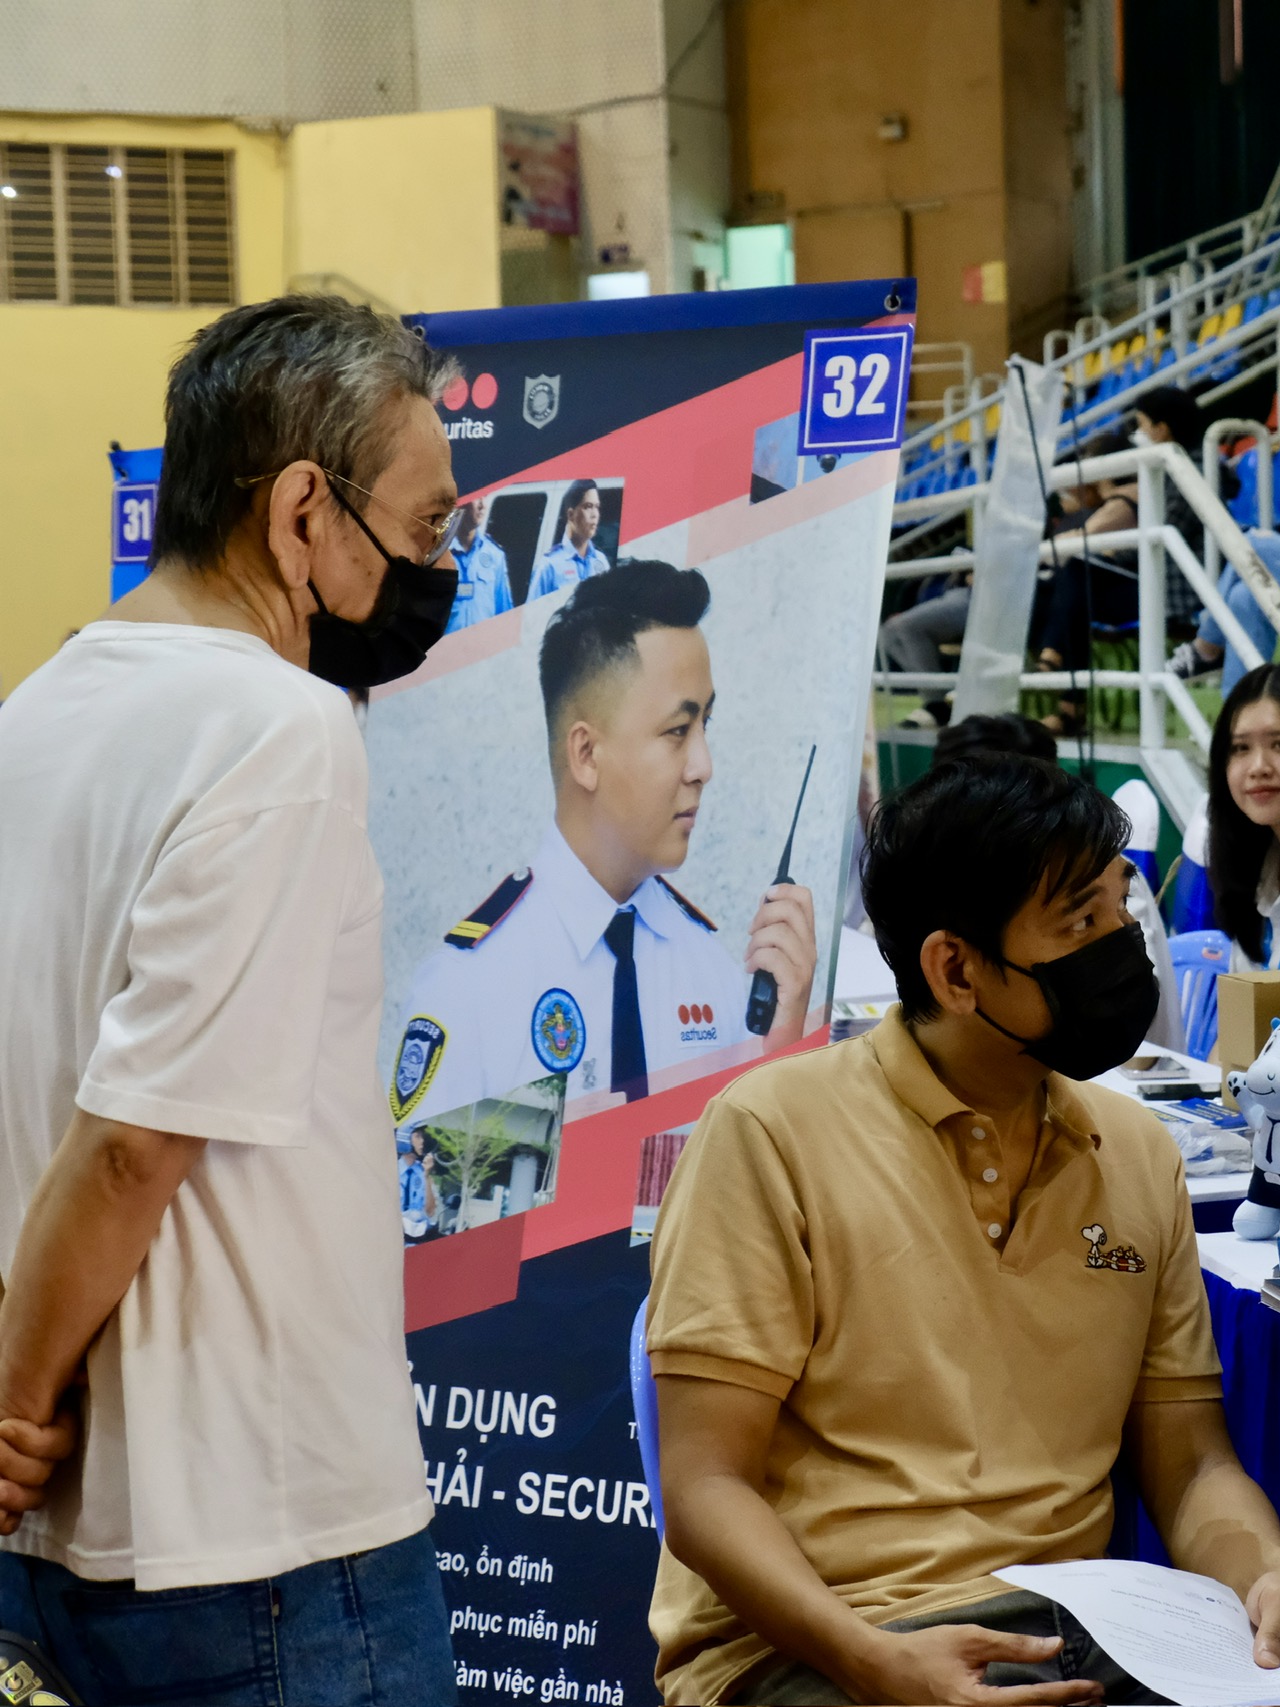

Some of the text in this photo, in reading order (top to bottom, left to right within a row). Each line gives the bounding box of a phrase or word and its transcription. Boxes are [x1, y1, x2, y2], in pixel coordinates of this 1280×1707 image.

[822, 353, 891, 418] 32
[443, 416, 494, 440] uritas
[123, 498, 151, 542] 31
[445, 1386, 557, 1443] DỤNG
[476, 1545, 503, 1577] ổn
[508, 1554, 554, 1586] định
[450, 1605, 598, 1649] phục miễn phí
[493, 1666, 535, 1699] việc
[540, 1668, 579, 1703] gần
[585, 1680, 625, 1707] nhà
